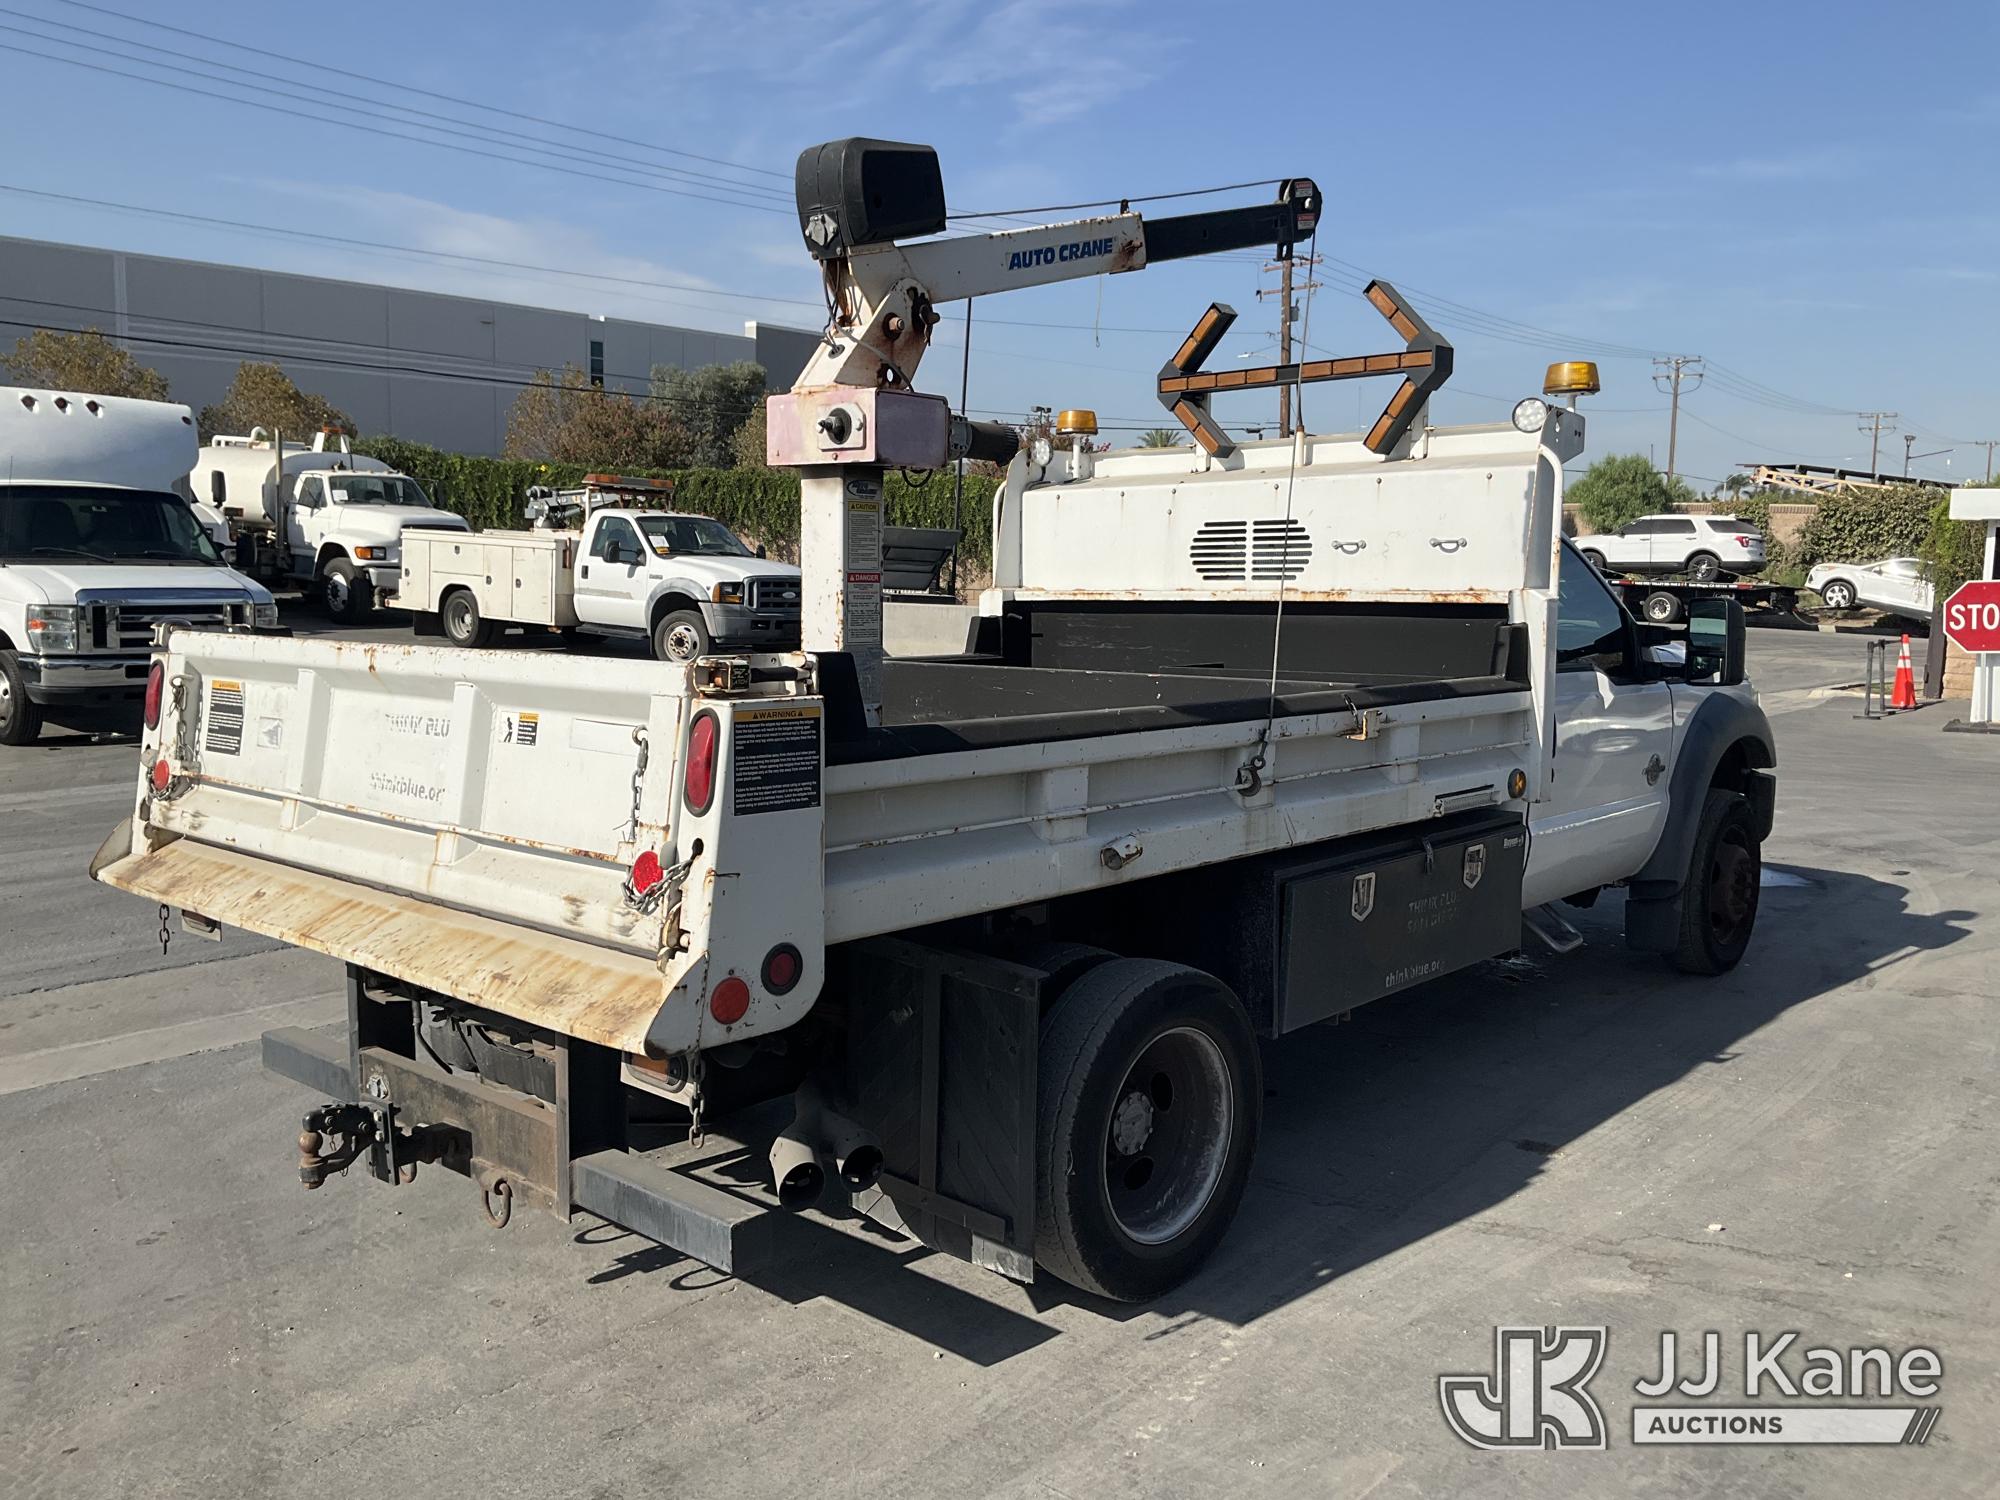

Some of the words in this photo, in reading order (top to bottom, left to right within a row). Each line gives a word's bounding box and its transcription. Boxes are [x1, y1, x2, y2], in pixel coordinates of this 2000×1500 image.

[1009, 247, 1056, 271] AUTO
[1059, 237, 1113, 262] CRANE
[1949, 603, 2000, 631] STO
[759, 710, 797, 720] WARNING
[371, 772, 446, 802] thinkblue.or
[1385, 960, 1445, 988] thinkblue.or
